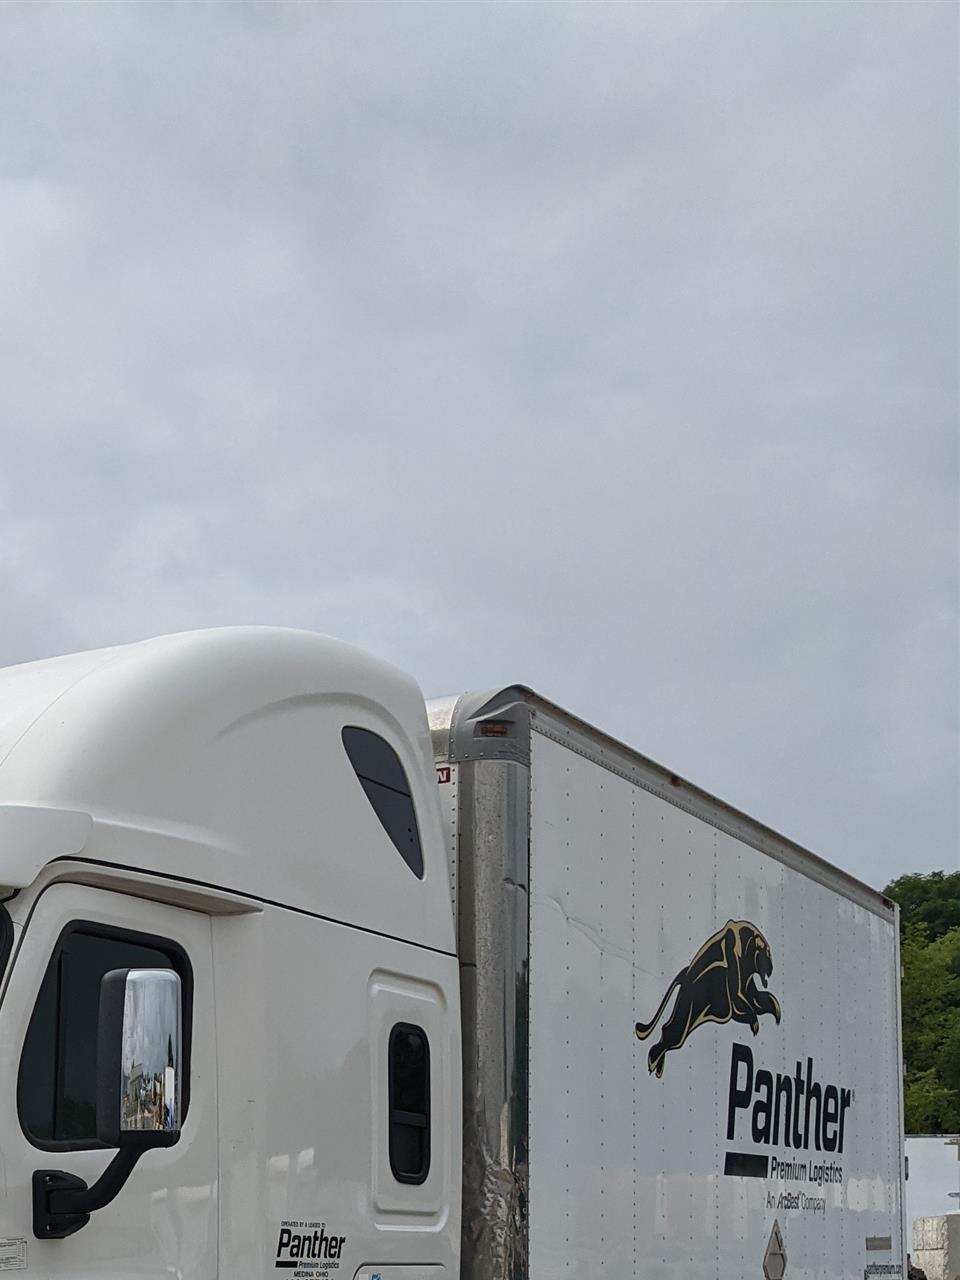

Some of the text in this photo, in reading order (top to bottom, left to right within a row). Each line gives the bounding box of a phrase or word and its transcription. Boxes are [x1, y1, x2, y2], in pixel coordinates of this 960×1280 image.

[727, 1042, 851, 1154] Panther
[771, 1156, 843, 1187] Premium Logistics
[766, 1191, 776, 1209] An
[801, 1193, 826, 1215] Company
[277, 1228, 346, 1259] Panther
[293, 1270, 329, 1278] MEDINA OHIO
[299, 1260, 340, 1270] Premium Logistics
